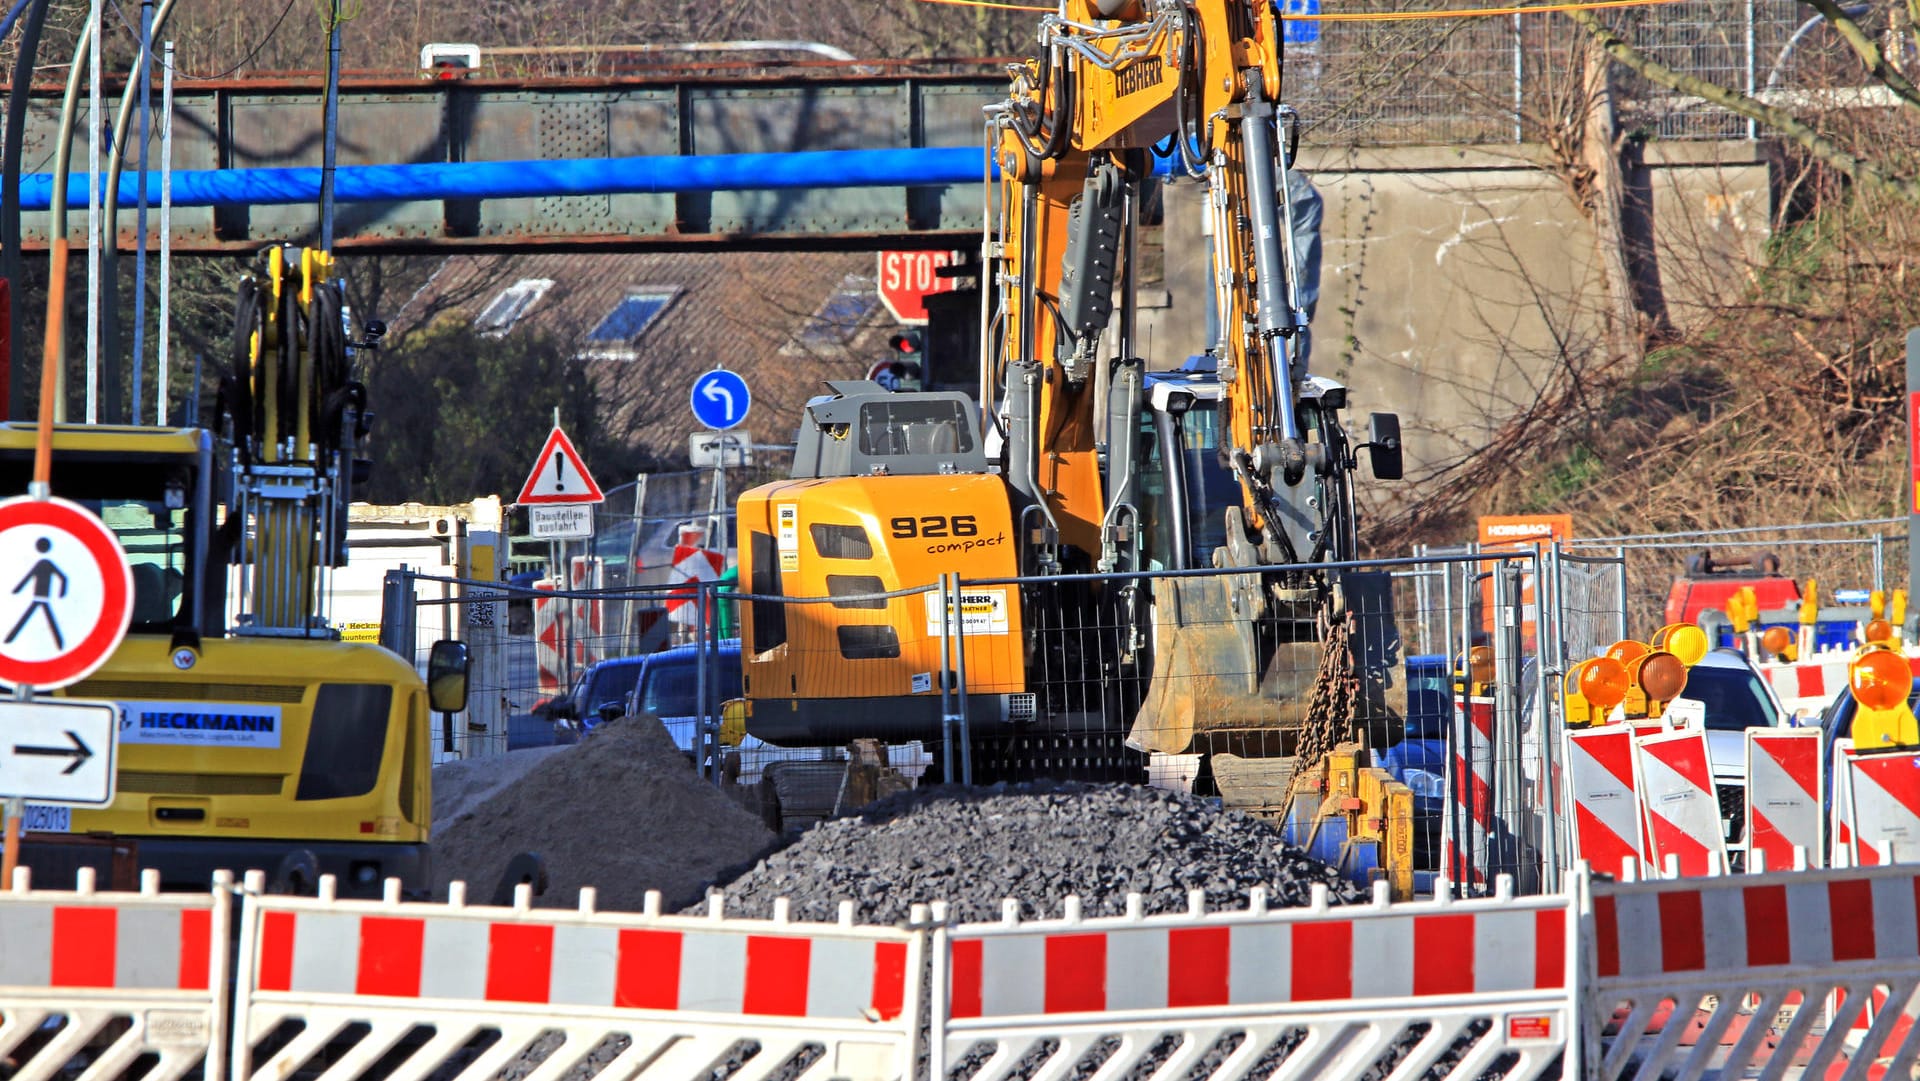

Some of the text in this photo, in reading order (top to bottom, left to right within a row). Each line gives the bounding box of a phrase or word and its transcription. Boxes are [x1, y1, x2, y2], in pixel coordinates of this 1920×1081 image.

[1115, 55, 1163, 98] LIEBHERR
[886, 253, 948, 291] STOP
[535, 509, 588, 521] Baustellen-
[891, 515, 978, 538] 926
[926, 531, 1005, 553] compact
[140, 711, 275, 733] HECKMANN
